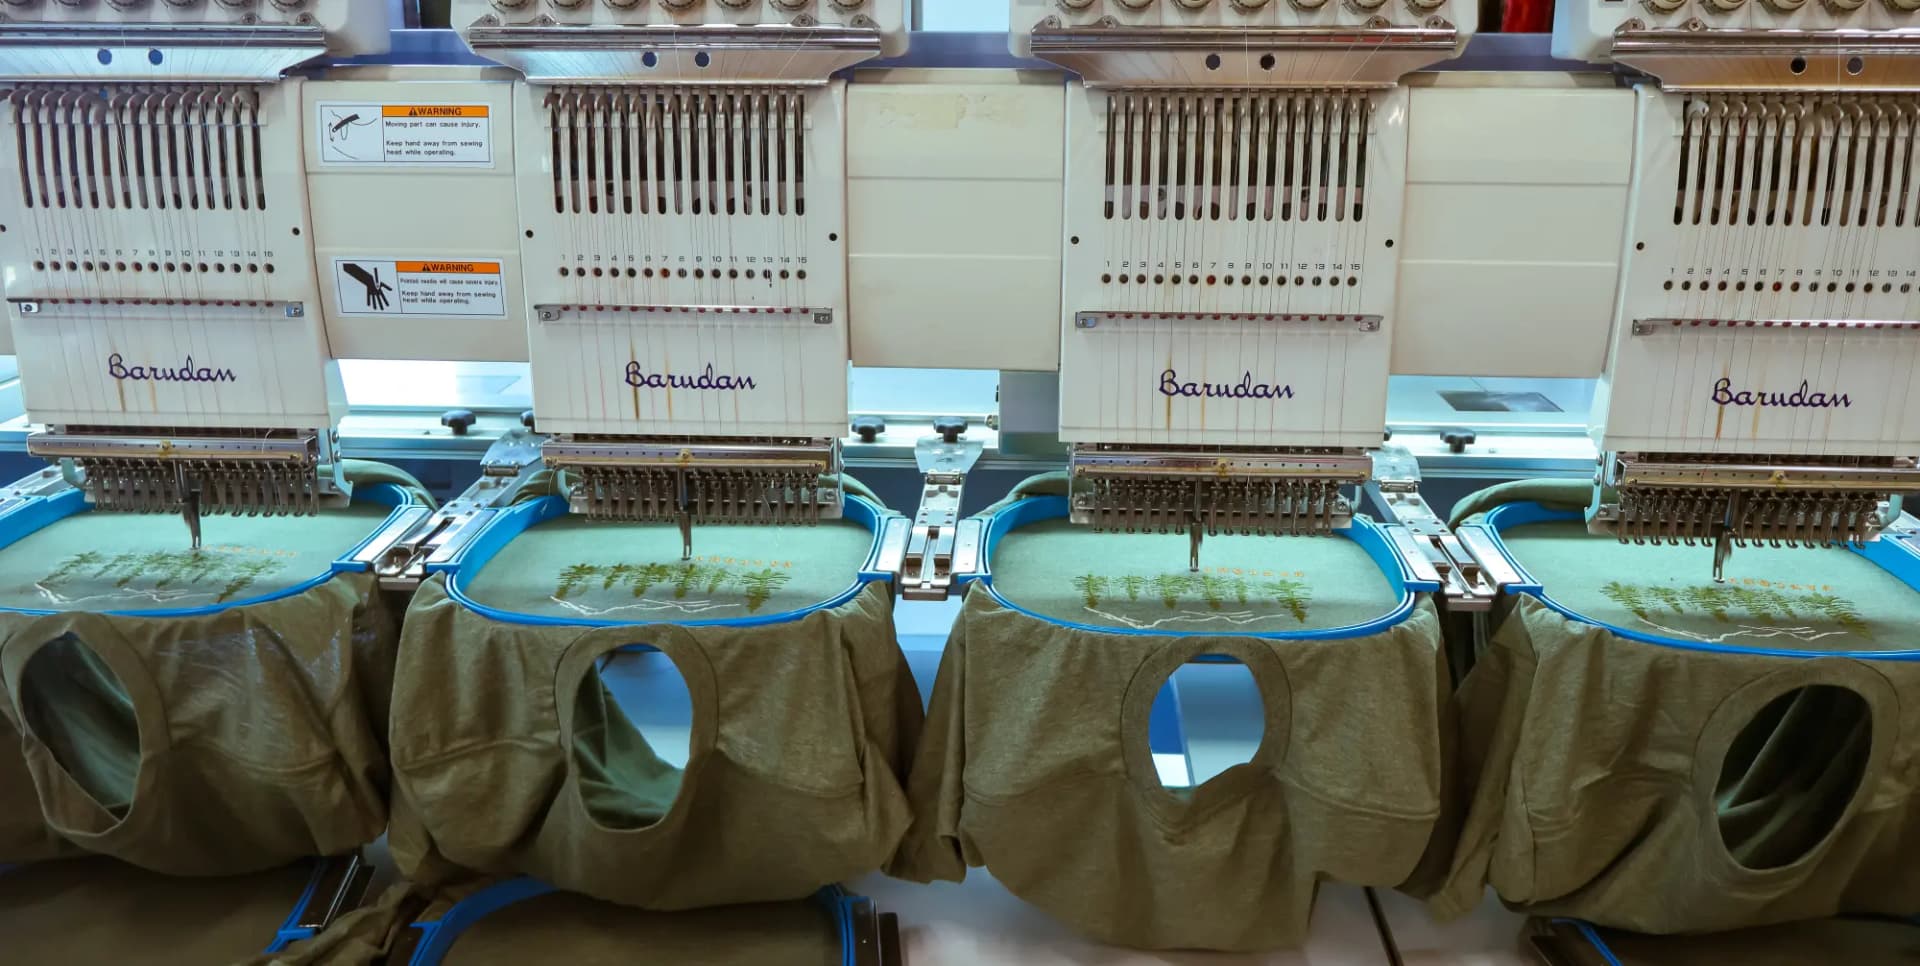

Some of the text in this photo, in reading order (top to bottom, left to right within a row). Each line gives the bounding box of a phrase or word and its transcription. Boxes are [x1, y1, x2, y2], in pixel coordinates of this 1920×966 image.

[431, 264, 474, 272] WARNING
[109, 353, 236, 382] Barudan
[625, 361, 756, 389] Barudan
[1159, 369, 1294, 398] Barudan
[1712, 378, 1851, 407] Barudan
